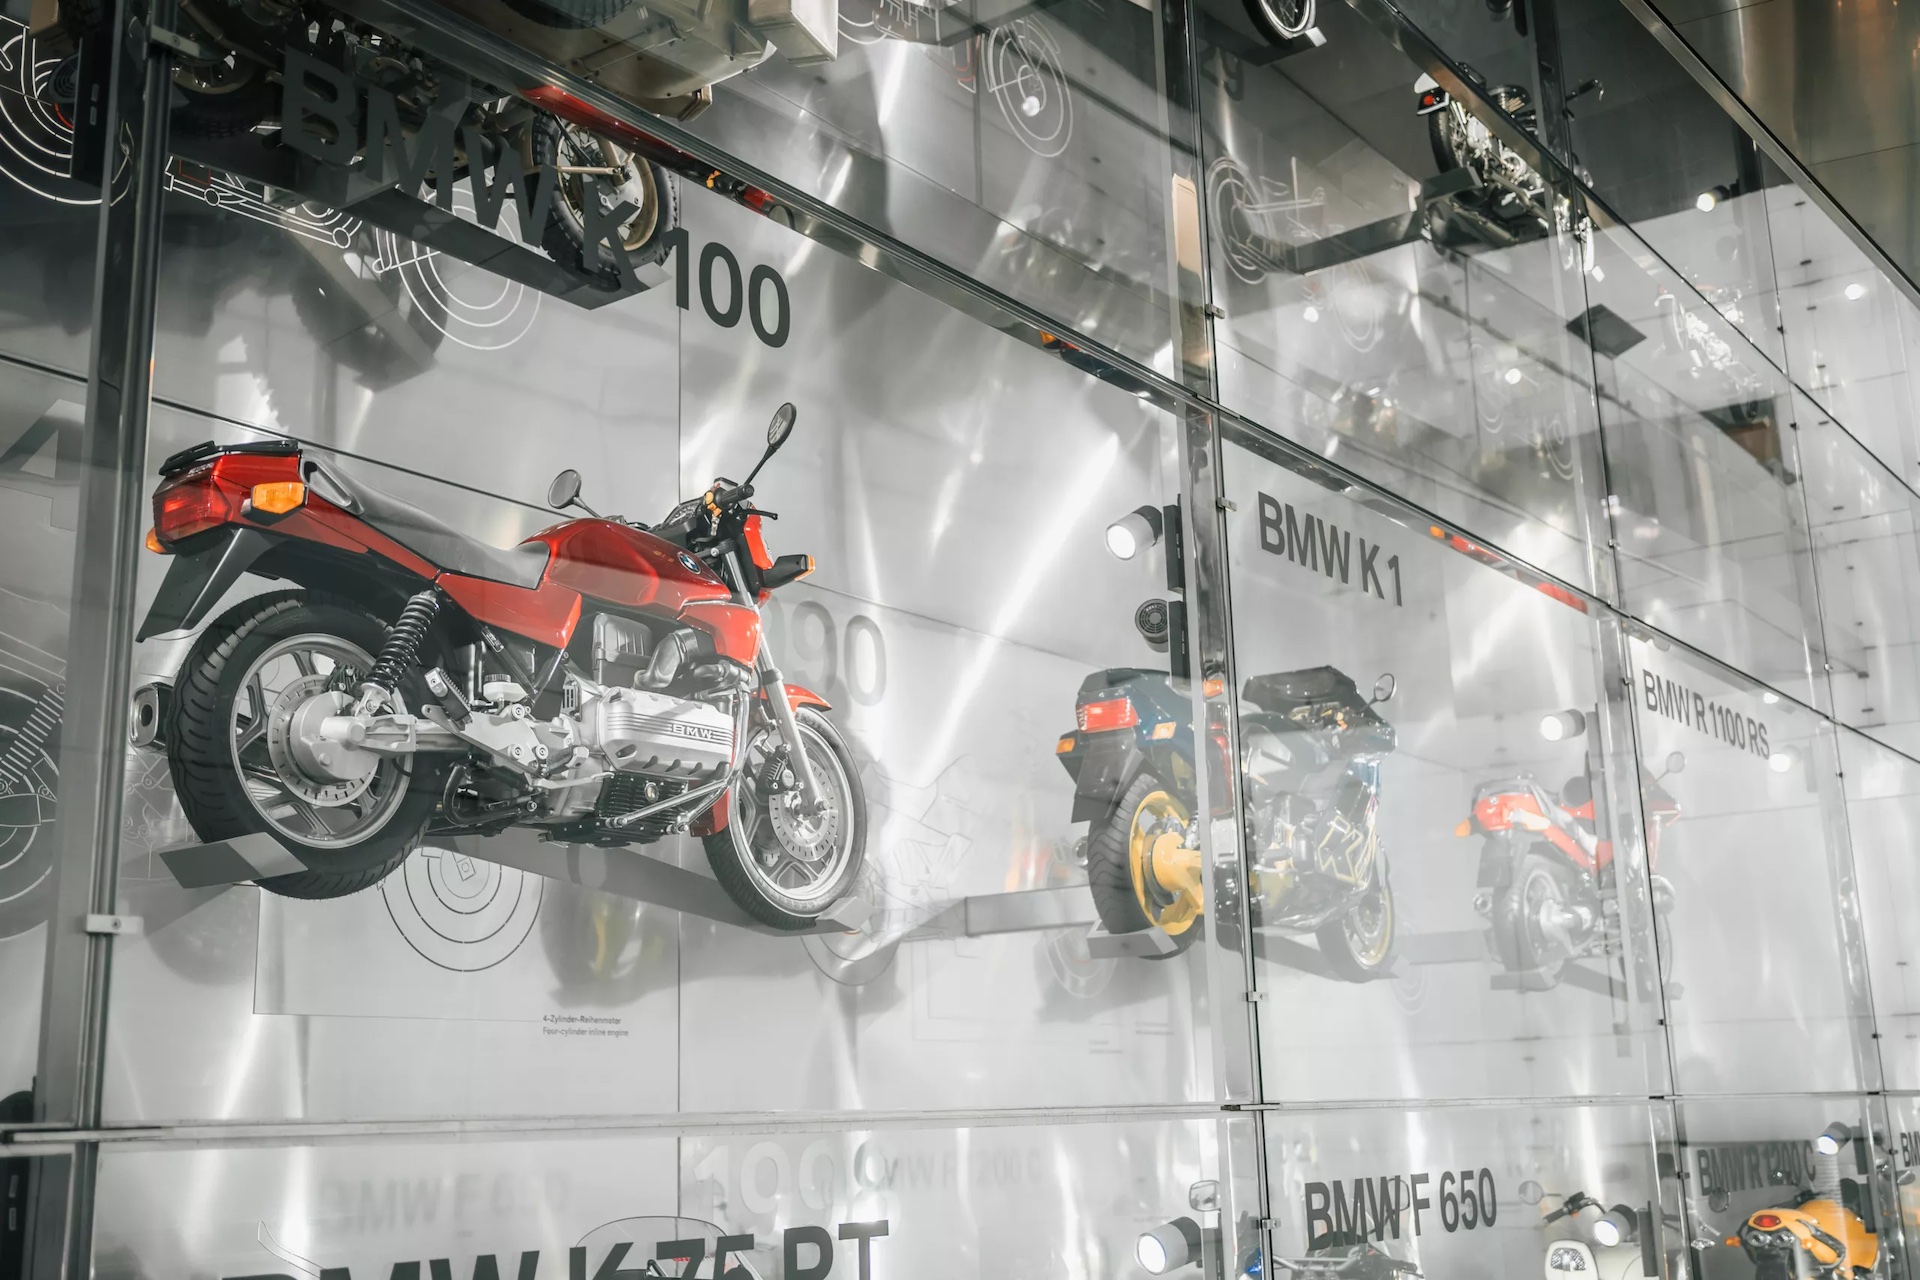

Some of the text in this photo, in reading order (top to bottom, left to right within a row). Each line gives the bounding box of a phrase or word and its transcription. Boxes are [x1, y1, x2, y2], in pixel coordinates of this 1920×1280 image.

[282, 43, 790, 348] BMW K 100
[1258, 491, 1351, 585] BMW
[672, 724, 713, 740] BMW
[1643, 669, 1770, 760] BMW R 1100 RS
[542, 1026, 629, 1038] Four-cylinder inline engine
[1304, 1167, 1497, 1252] BMW F 650
[1697, 1144, 1745, 1195] BMW
[1747, 1144, 1763, 1188] R
[1804, 1140, 1816, 1182] C
